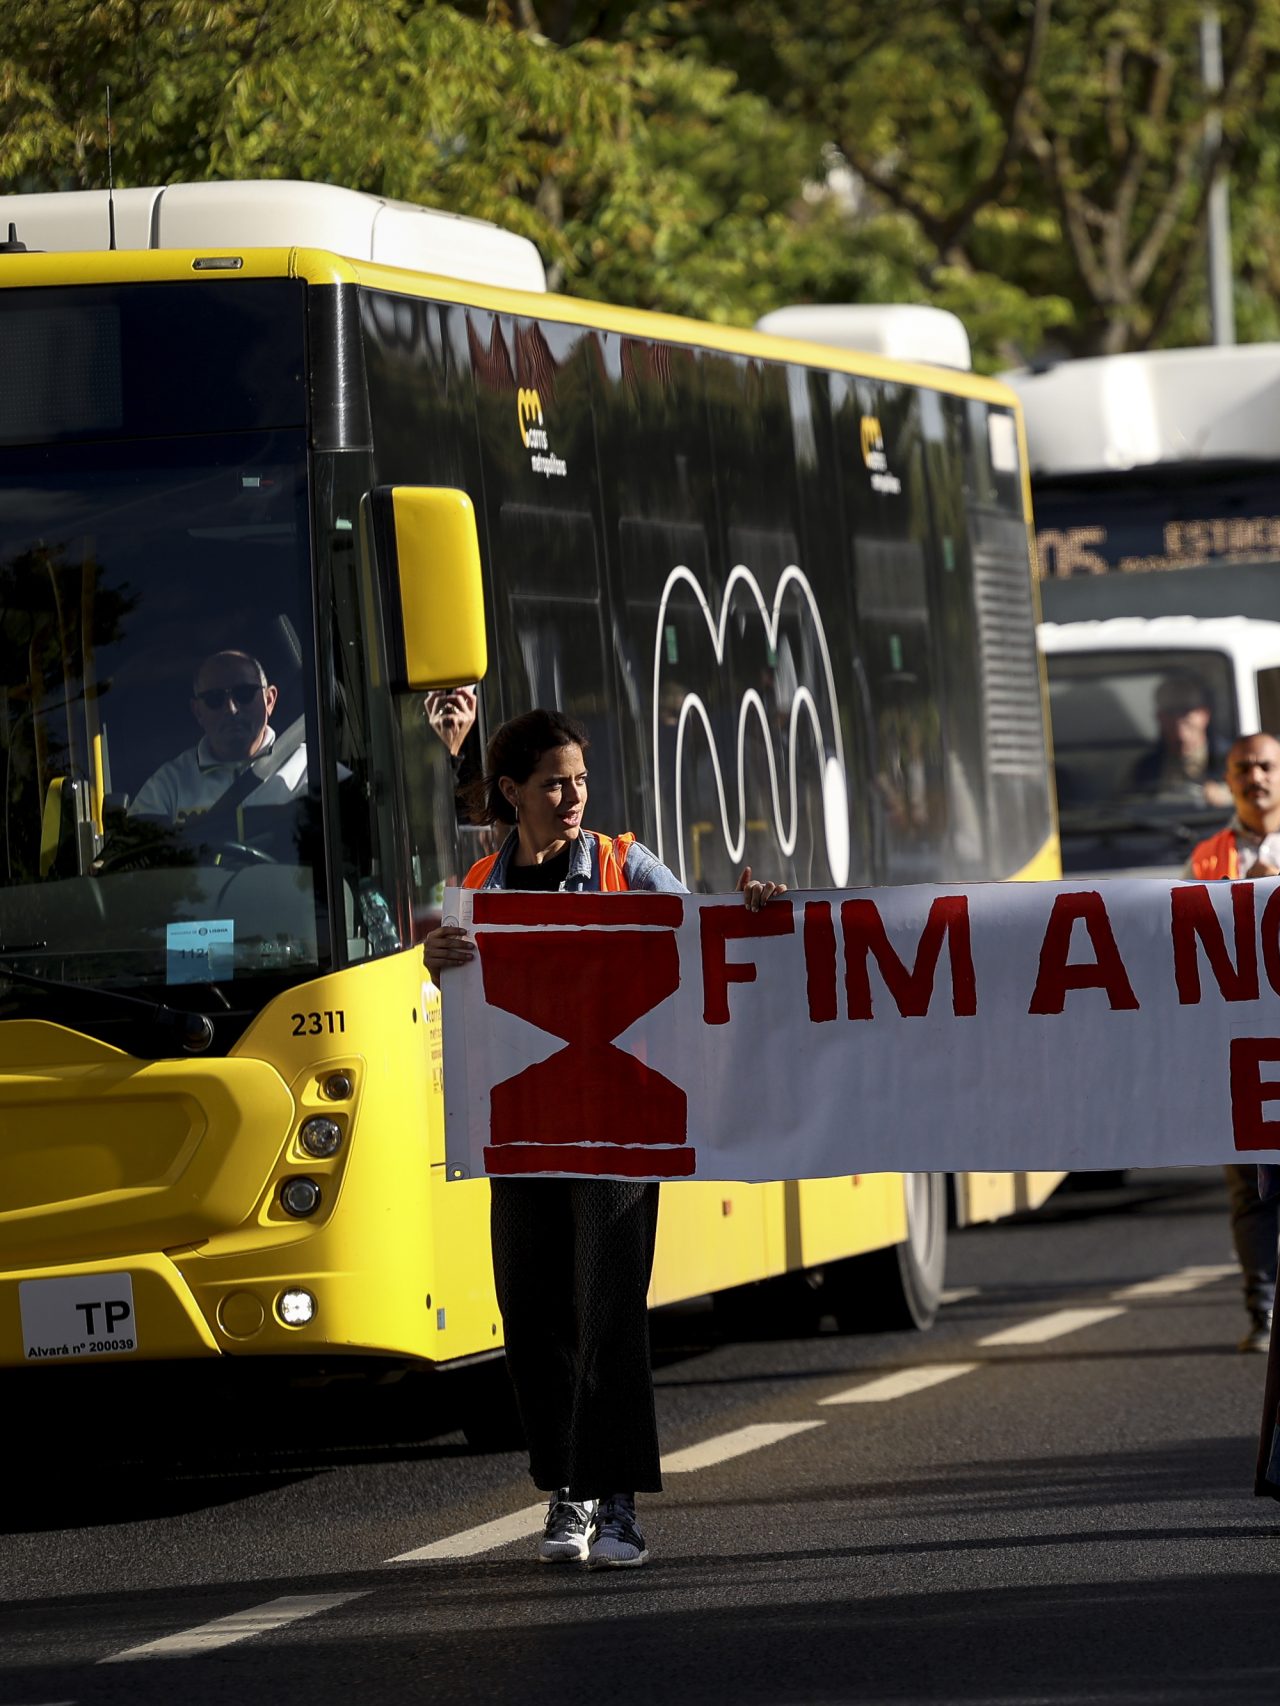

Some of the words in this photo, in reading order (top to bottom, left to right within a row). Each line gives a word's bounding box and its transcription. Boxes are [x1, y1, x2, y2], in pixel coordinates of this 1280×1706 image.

[701, 896, 976, 1024] FIM
[1032, 893, 1137, 1012] A
[291, 1010, 345, 1037] 2311
[75, 1300, 131, 1336] TP
[28, 1343, 69, 1358] Alvará
[89, 1338, 134, 1353] 200039
